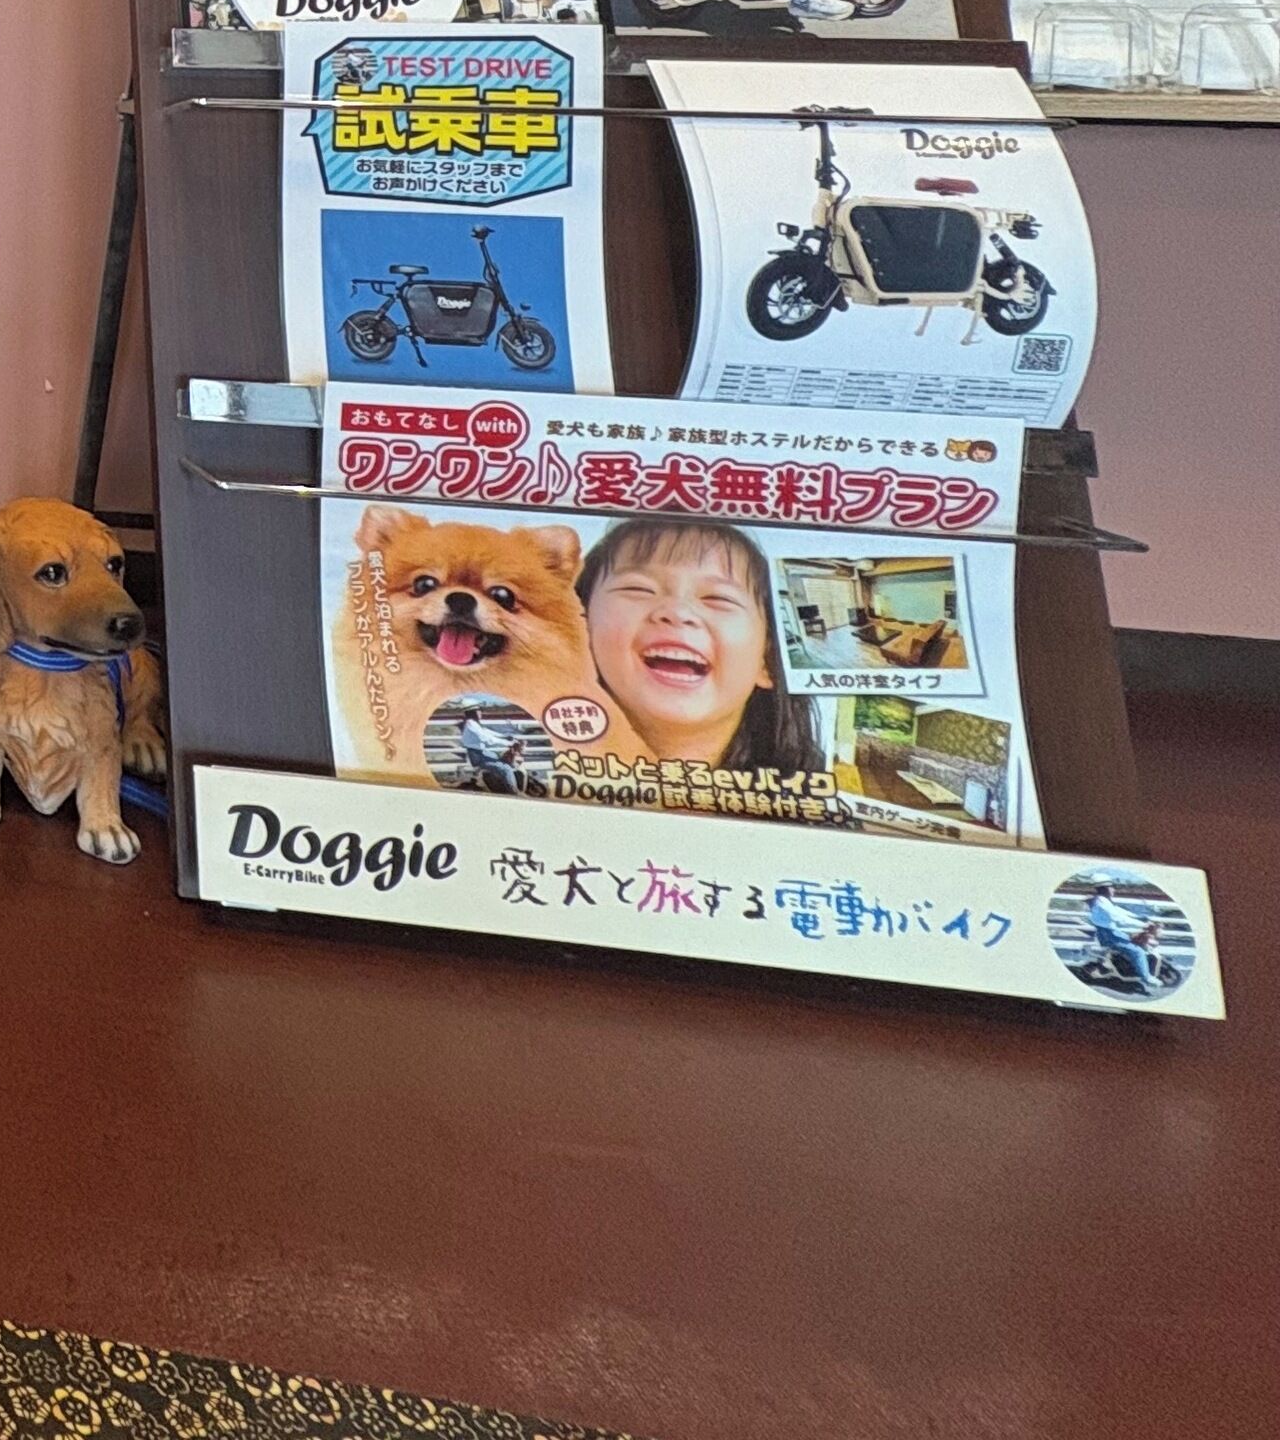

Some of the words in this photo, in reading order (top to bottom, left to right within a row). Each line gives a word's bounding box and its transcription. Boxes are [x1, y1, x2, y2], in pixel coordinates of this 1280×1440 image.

[383, 56, 453, 78] TEST
[464, 59, 552, 80] DRIVE
[334, 85, 559, 154] 試乗車
[900, 128, 1021, 159] Doggie
[356, 159, 523, 177] お気軽にスタッフまで
[372, 176, 506, 194] お声がけください
[350, 409, 459, 431] おもてなし
[475, 416, 519, 434] with
[368, 551, 401, 673] 愛犬と泊まれる
[804, 673, 942, 689] 人気の洋室タイプ
[552, 775, 659, 807] Doggie
[228, 804, 458, 891] Doggie
[243, 863, 326, 885] E-CarryBike
[491, 848, 1012, 948] 愛犬と旅する電動バイク
